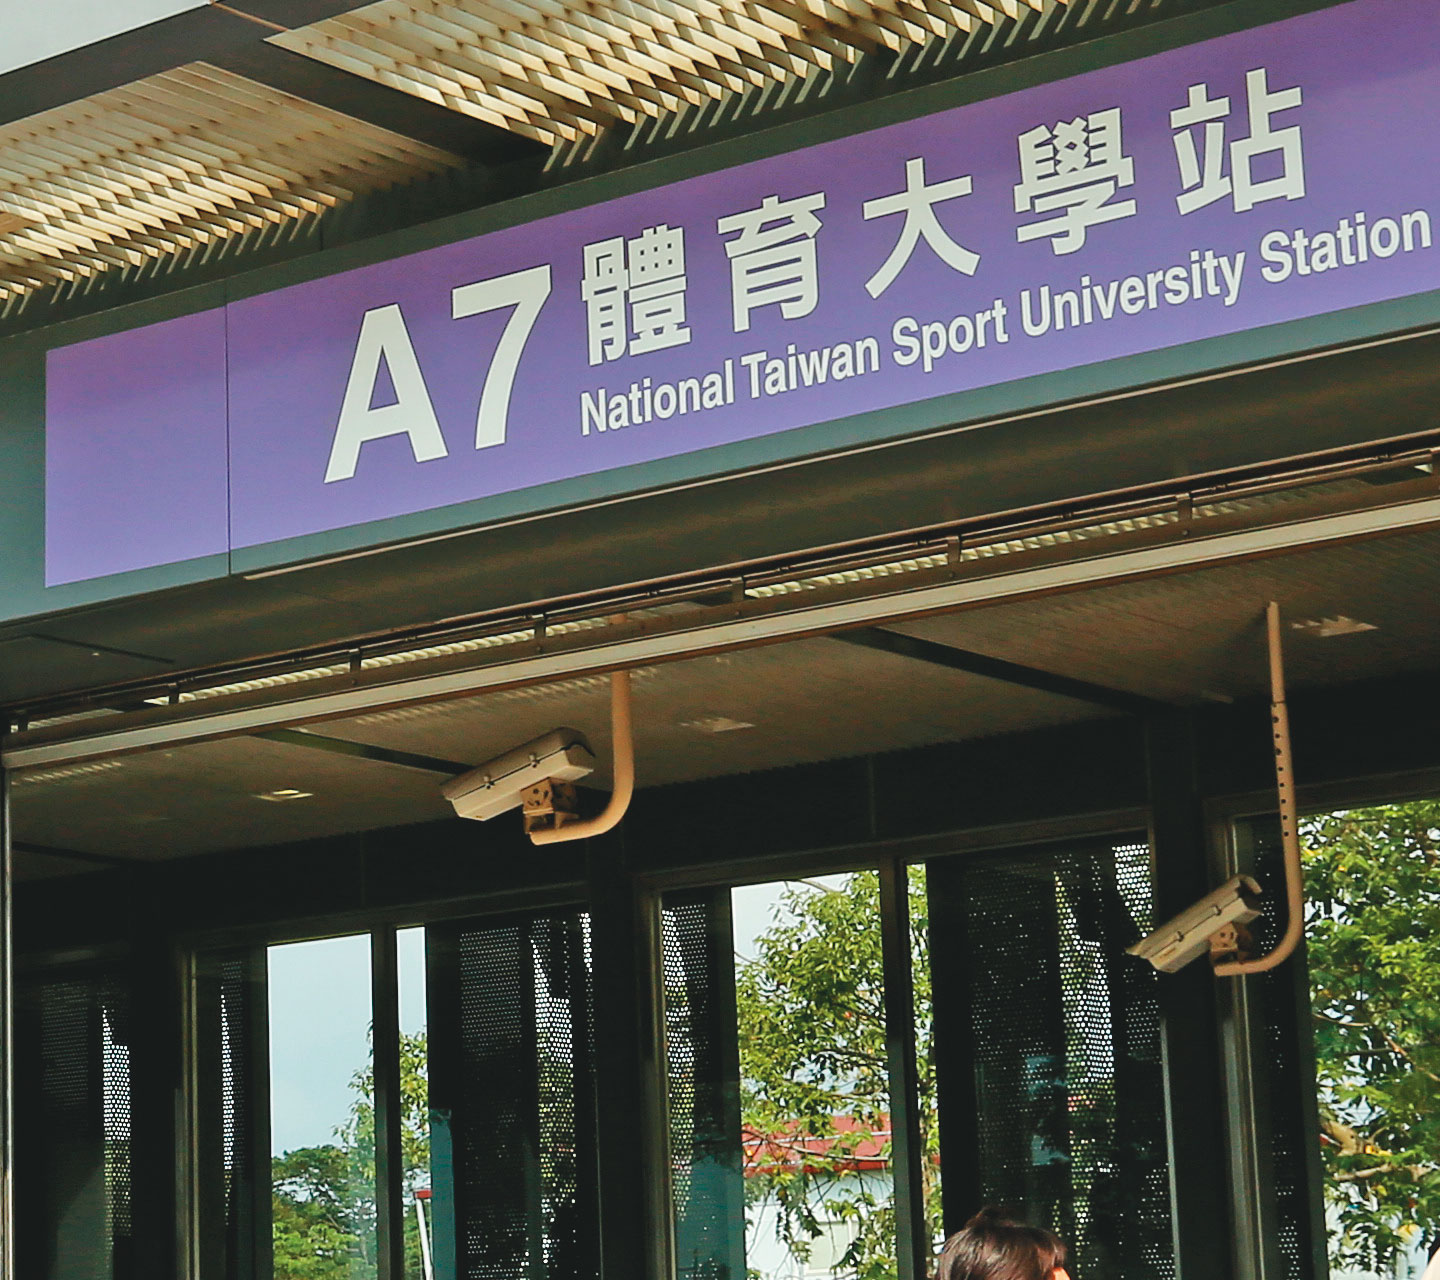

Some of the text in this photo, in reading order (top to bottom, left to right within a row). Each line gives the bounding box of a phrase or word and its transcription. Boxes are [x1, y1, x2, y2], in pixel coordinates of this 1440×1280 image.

[579, 65, 1307, 368] 體育大學站
[579, 207, 1433, 437] National Taiwan Sport University Station
[323, 263, 553, 485] A7
